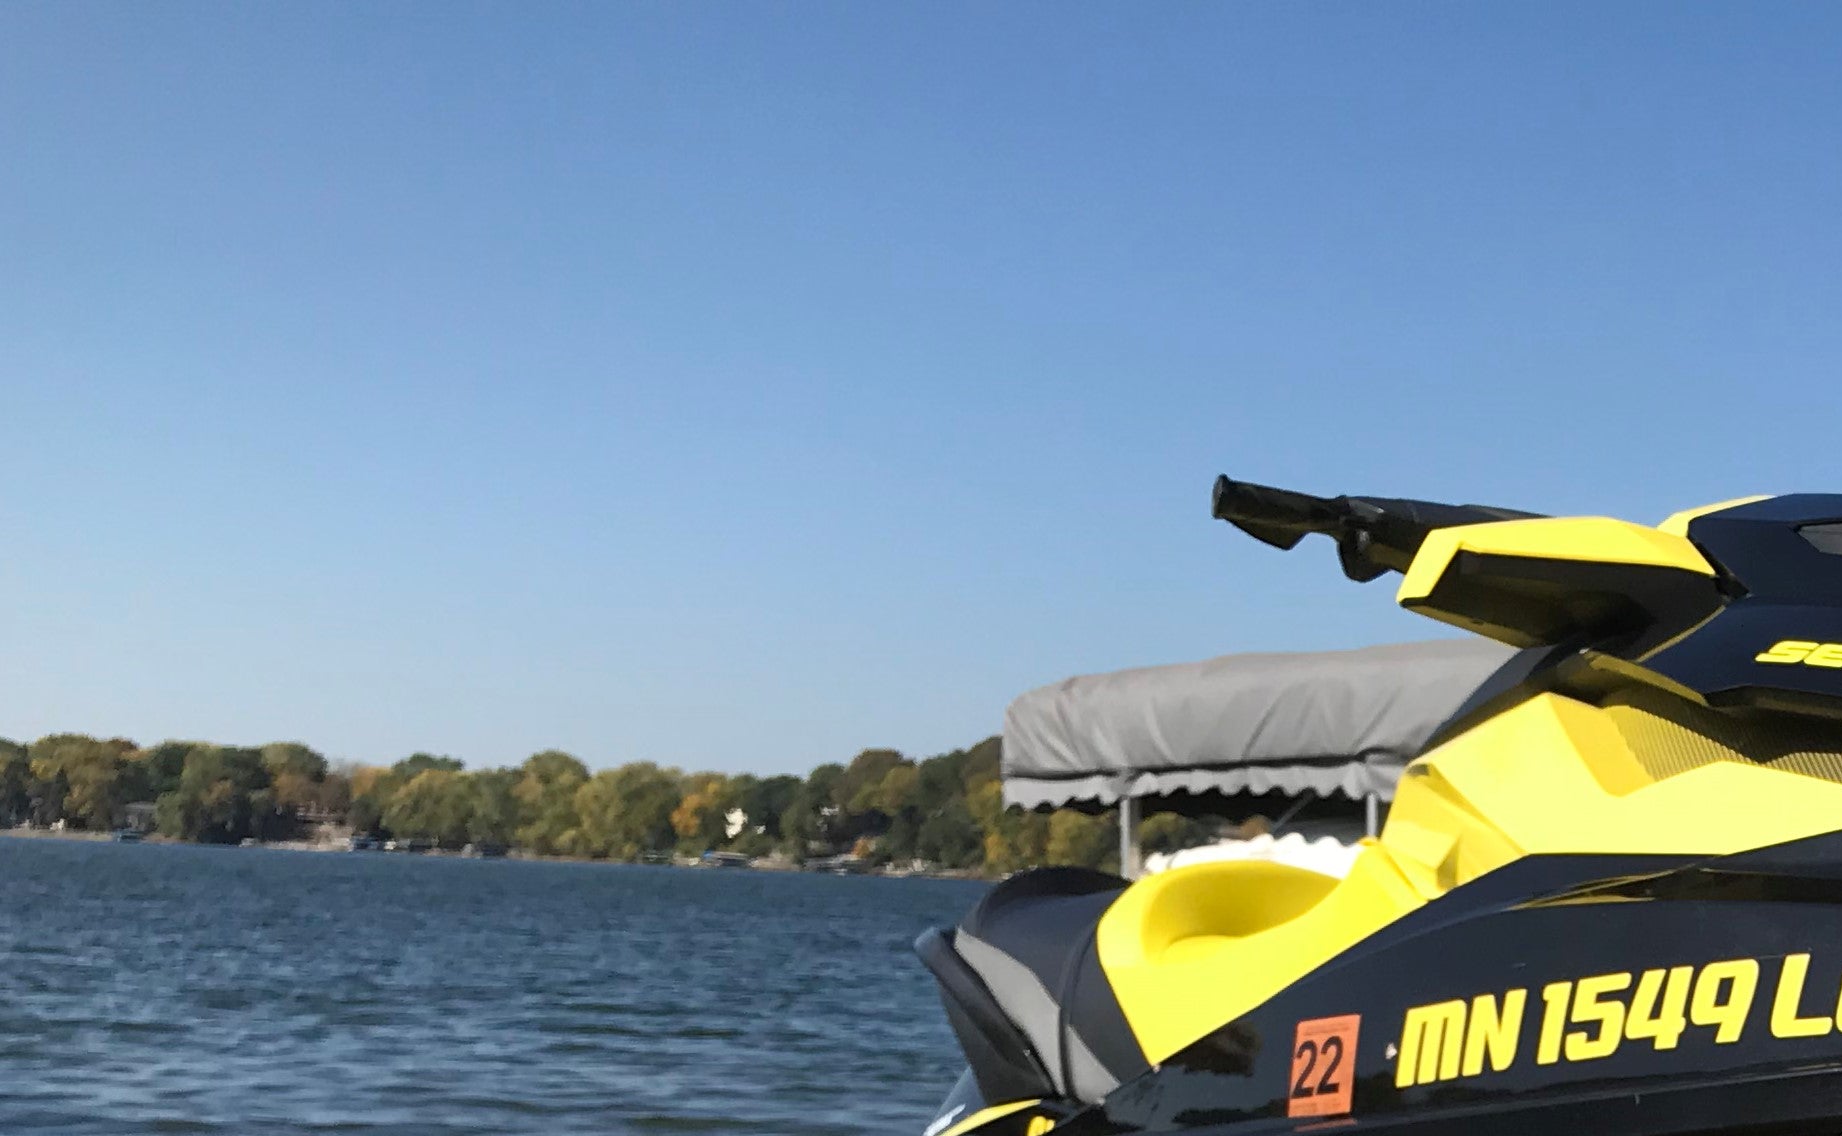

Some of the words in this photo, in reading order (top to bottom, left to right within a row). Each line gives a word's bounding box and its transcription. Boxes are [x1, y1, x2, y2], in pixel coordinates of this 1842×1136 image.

[1290, 1035, 1344, 1099] 22
[1394, 987, 1528, 1089] MN
[1536, 957, 1760, 1065] 1549
